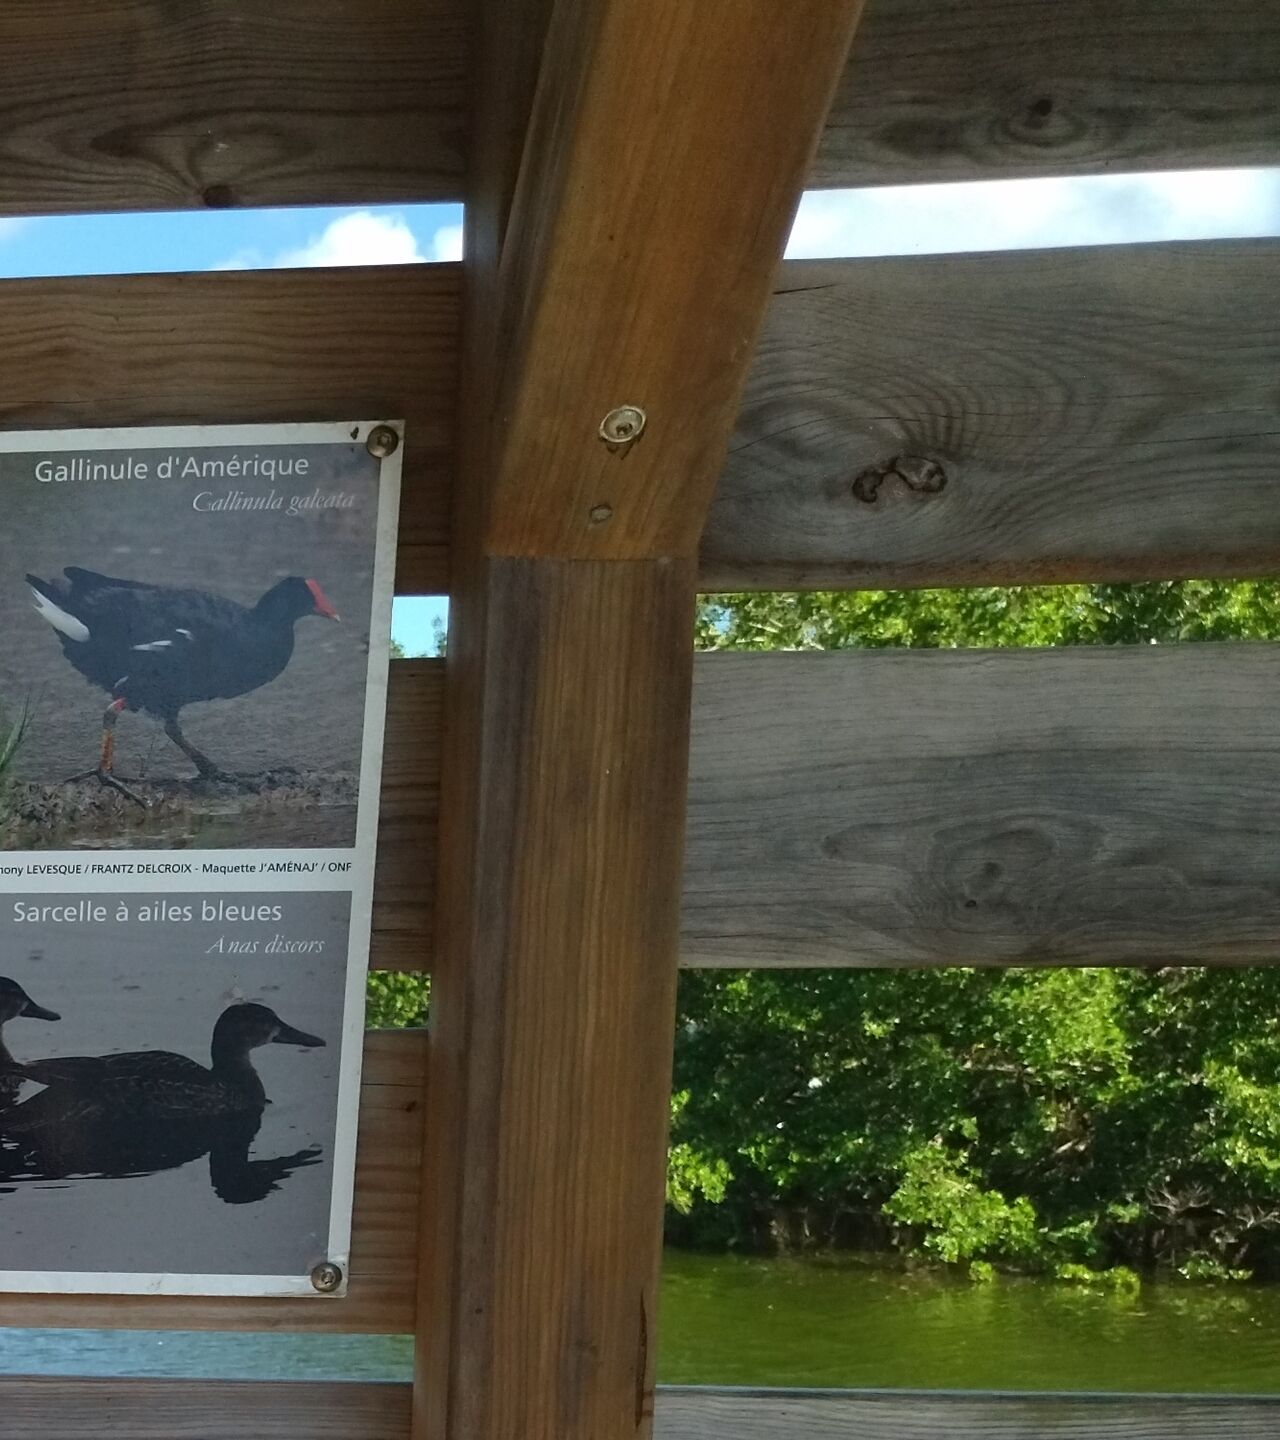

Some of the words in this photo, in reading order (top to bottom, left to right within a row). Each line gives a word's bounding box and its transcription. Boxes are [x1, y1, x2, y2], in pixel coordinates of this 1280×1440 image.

[34, 458, 149, 483] Gallinule
[191, 490, 284, 513] Gallinula
[286, 490, 355, 515] galeata
[26, 863, 82, 876] LEVESQUE
[91, 863, 134, 875] FRANTZ
[136, 863, 192, 875] DELCROIX
[201, 861, 256, 876] Maquette
[328, 861, 352, 873] ONF
[13, 901, 108, 922] Sarcelle
[116, 901, 130, 922] à
[137, 901, 193, 922] ailes
[201, 901, 283, 922] bleues
[205, 936, 259, 955] Anas
[264, 935, 326, 954] discors
